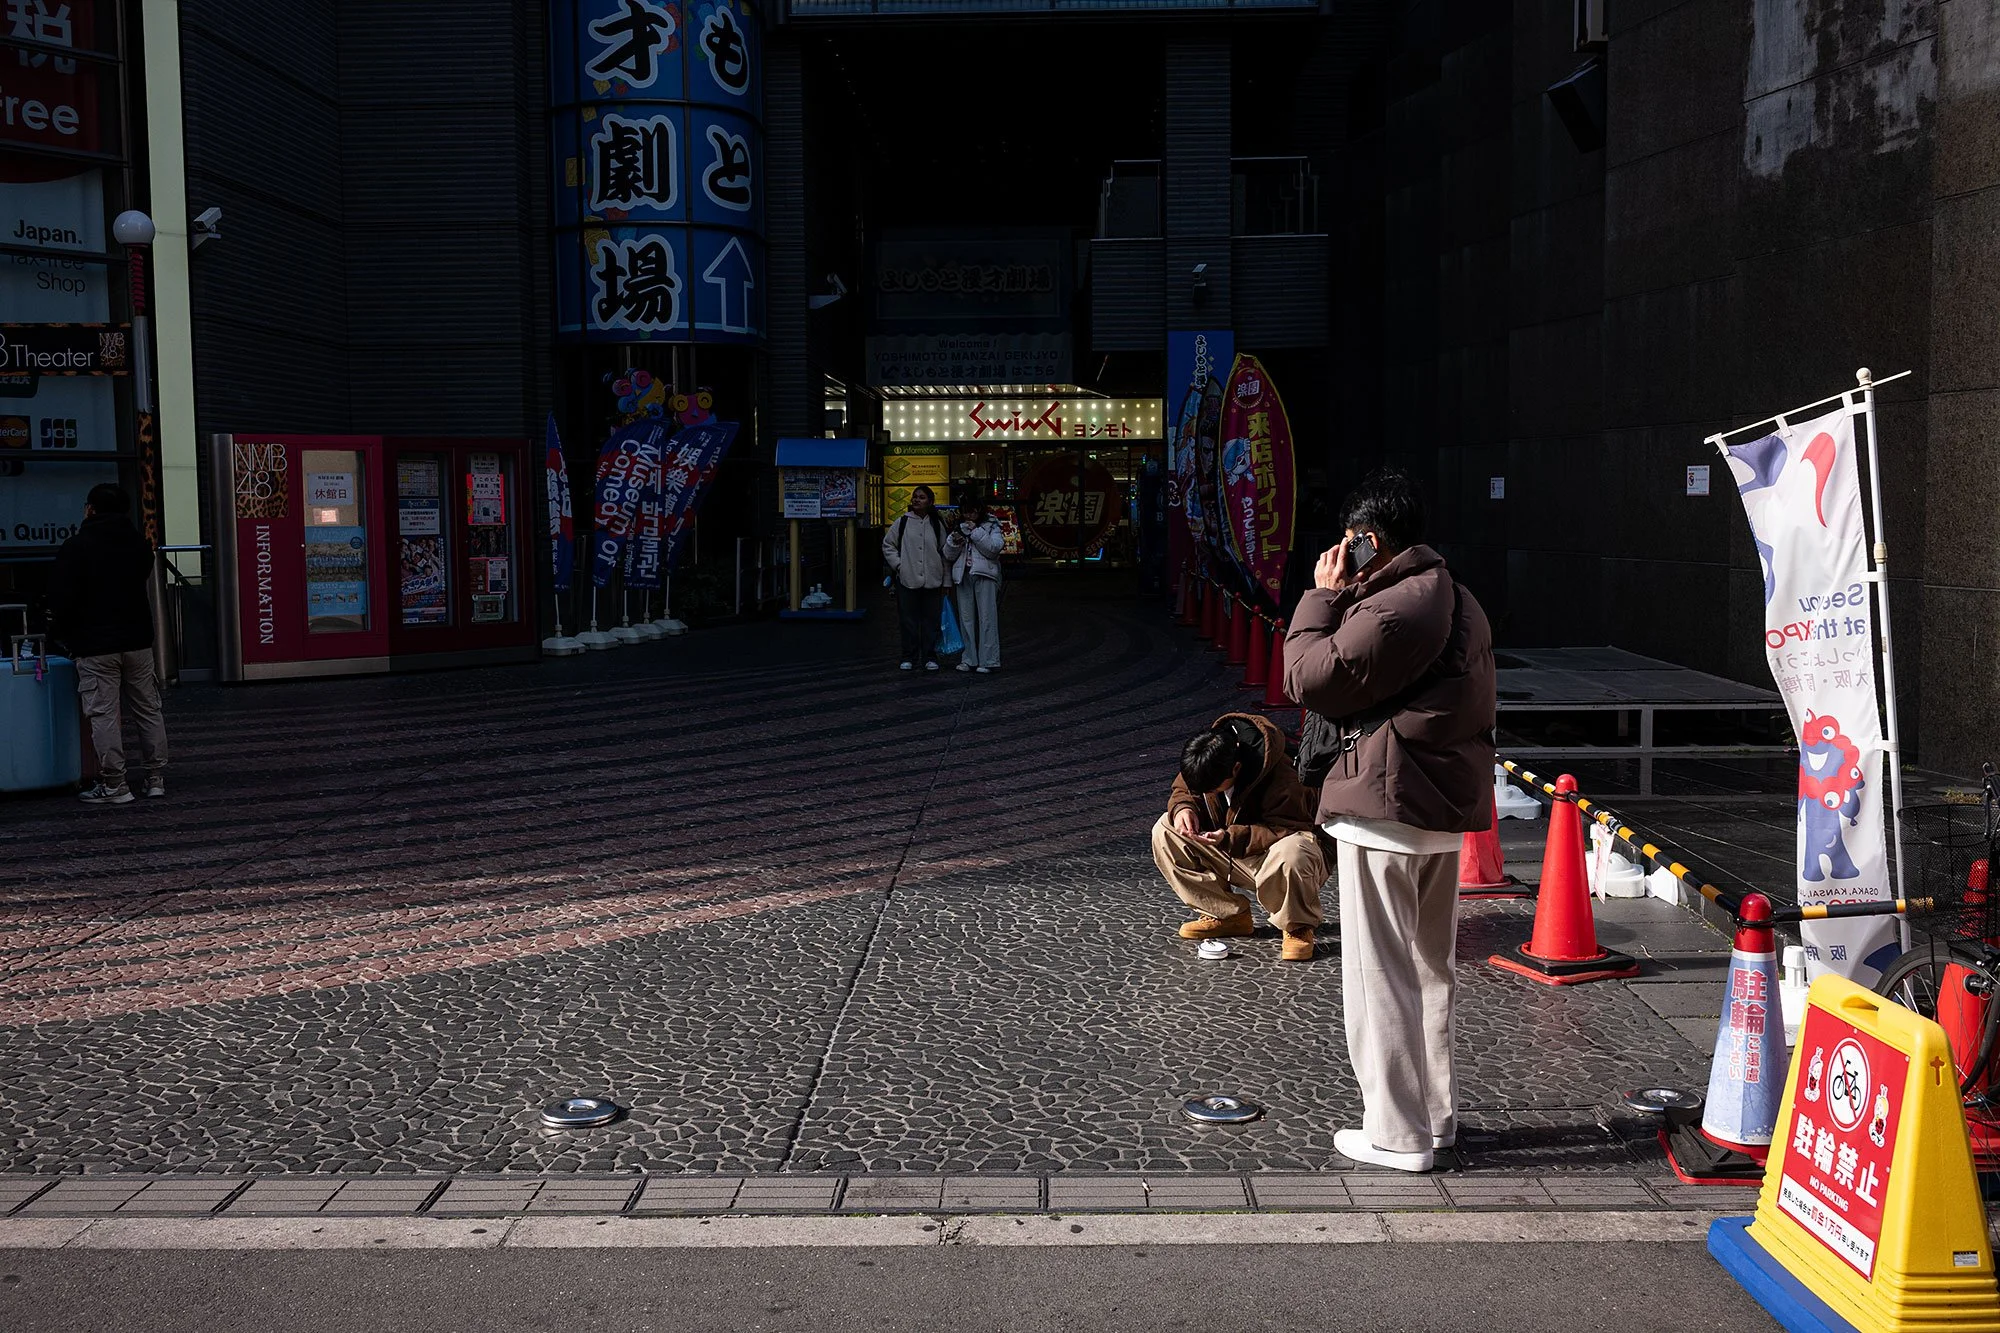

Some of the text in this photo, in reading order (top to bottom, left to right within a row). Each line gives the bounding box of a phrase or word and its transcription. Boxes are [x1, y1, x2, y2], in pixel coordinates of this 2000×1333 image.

[7, 0, 73, 47] 税
[0, 84, 80, 135] ree
[700, 5, 752, 212] もと
[586, 0, 682, 332] 才劇場
[13, 220, 82, 245] Japan.
[36, 271, 86, 297] Shop
[879, 264, 1054, 294] よしもと漫才劇場
[11, 344, 95, 367] Theater
[874, 352, 947, 362] YOSHIMOTO
[951, 352, 1000, 361] MANZAI
[0, 427, 28, 438] erCard
[41, 427, 77, 439] JCB
[1074, 423, 1132, 438] ヨシモト
[235, 443, 288, 472] NMB
[236, 470, 272, 500] 48
[315, 488, 348, 500] 休館日
[1033, 488, 1106, 526] 楽園
[14, 523, 78, 544] Quijot
[255, 523, 274, 645] INFORMATION
[1793, 1112, 1879, 1208] 駐輪禁止
[1809, 1174, 1849, 1213] NO PARKING
